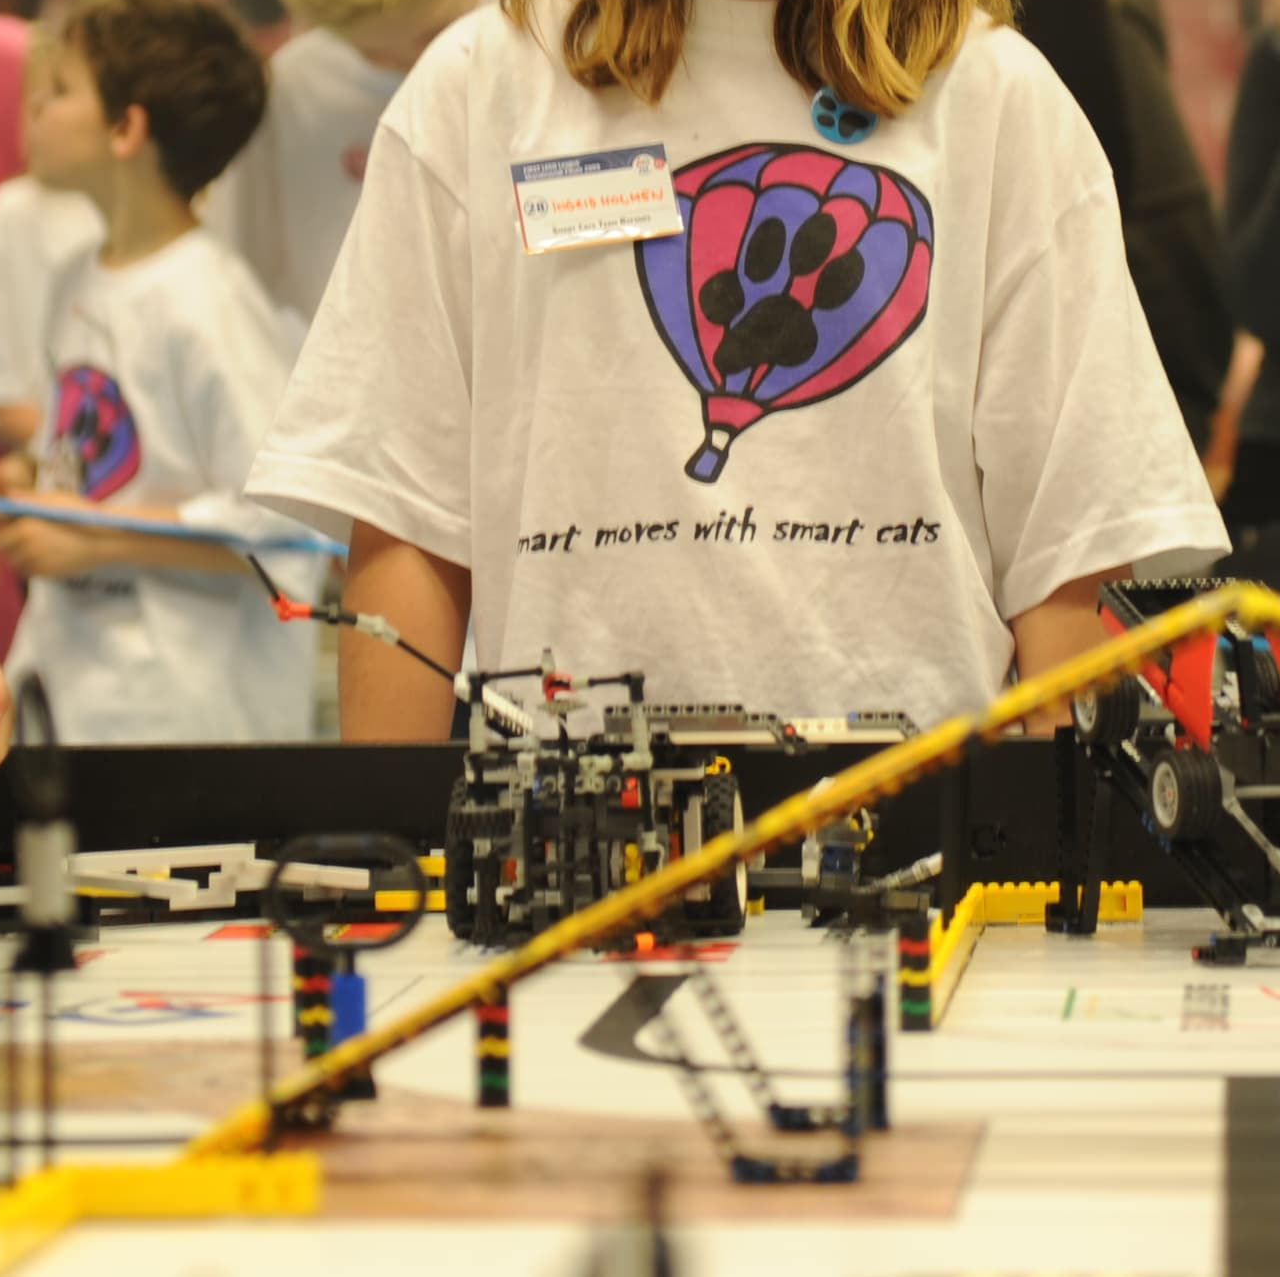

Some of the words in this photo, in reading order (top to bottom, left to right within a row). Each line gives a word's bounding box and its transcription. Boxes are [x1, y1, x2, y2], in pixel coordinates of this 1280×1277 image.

[595, 519, 680, 548] moves
[694, 506, 757, 543] with
[773, 518, 864, 546] smart
